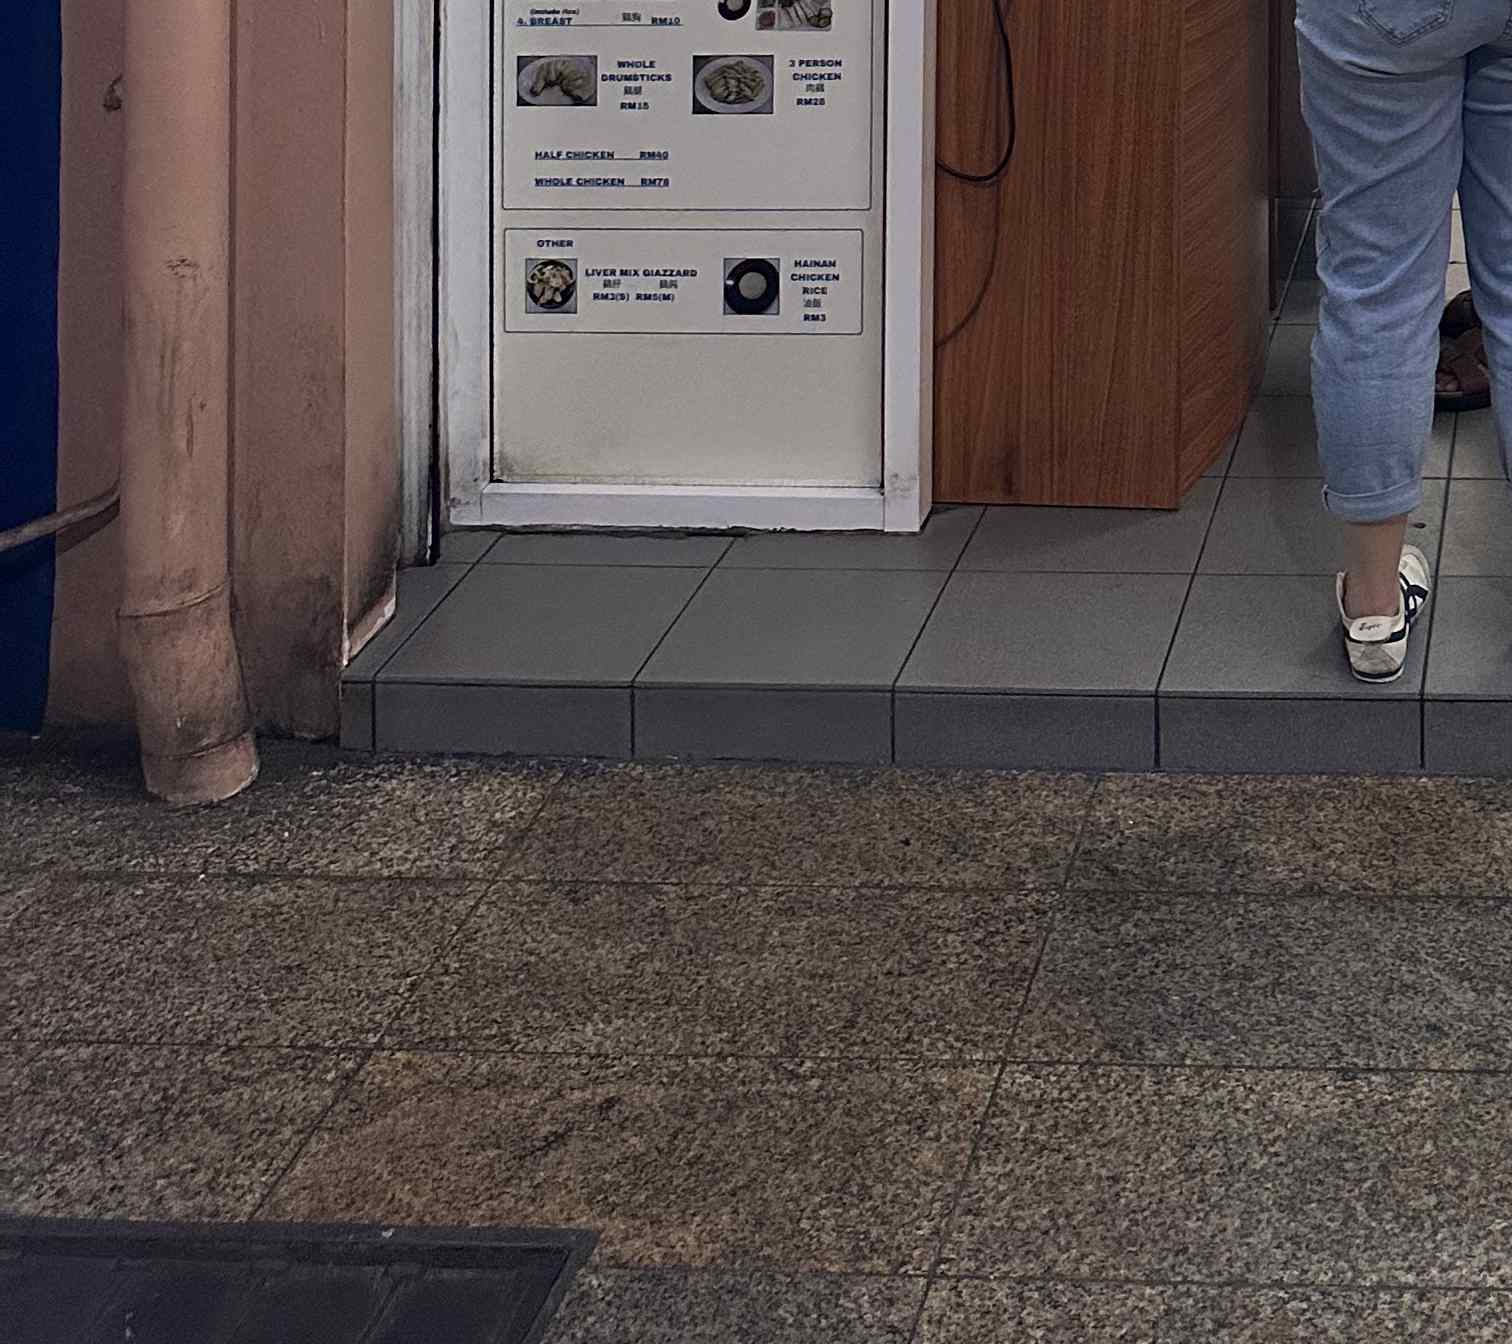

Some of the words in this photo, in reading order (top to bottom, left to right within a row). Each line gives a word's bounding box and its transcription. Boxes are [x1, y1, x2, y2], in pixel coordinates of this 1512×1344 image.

[530, 18, 573, 26] BREAST
[617, 60, 656, 68] WHOLE
[601, 74, 672, 82] DRUMSTICKS
[792, 73, 842, 81] CHICKEN
[535, 151, 563, 159] HALF
[565, 151, 615, 159] CHICKEN
[535, 178, 574, 186] WHOLE
[576, 178, 625, 186] CHICKEN
[536, 239, 574, 248] OTHER
[794, 260, 837, 268] HAINAN
[585, 269, 617, 277] LIVER
[619, 269, 640, 277] MIX
[790, 273, 840, 282] CHICKEN
[802, 287, 828, 295] RICE
